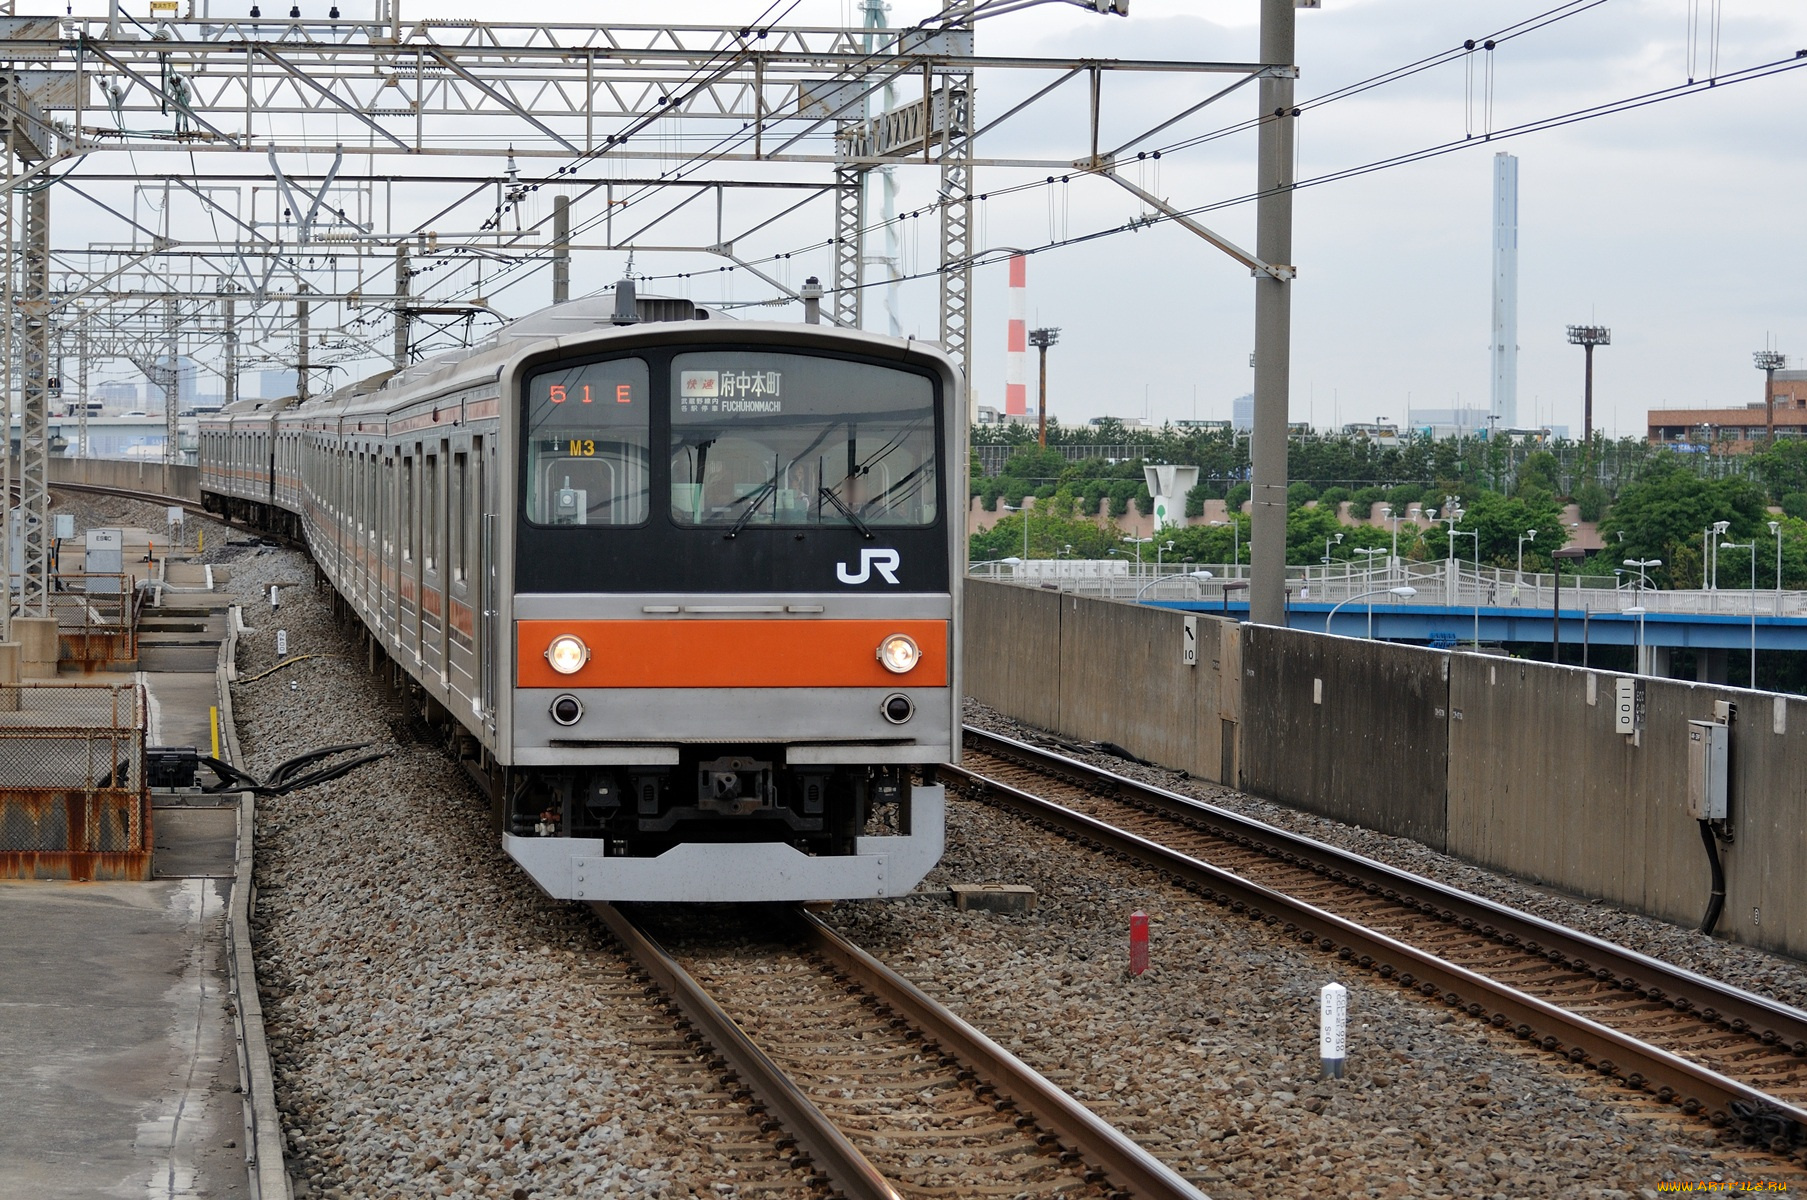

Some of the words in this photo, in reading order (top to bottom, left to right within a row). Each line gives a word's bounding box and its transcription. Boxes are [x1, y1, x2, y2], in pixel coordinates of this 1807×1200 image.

[686, 379, 714, 390] 快速
[720, 371, 782, 397] 府中本町
[570, 440, 595, 456] M3
[836, 548, 900, 584] JR
[1185, 650, 1194, 660] 10
[1621, 688, 1630, 724] 1100
